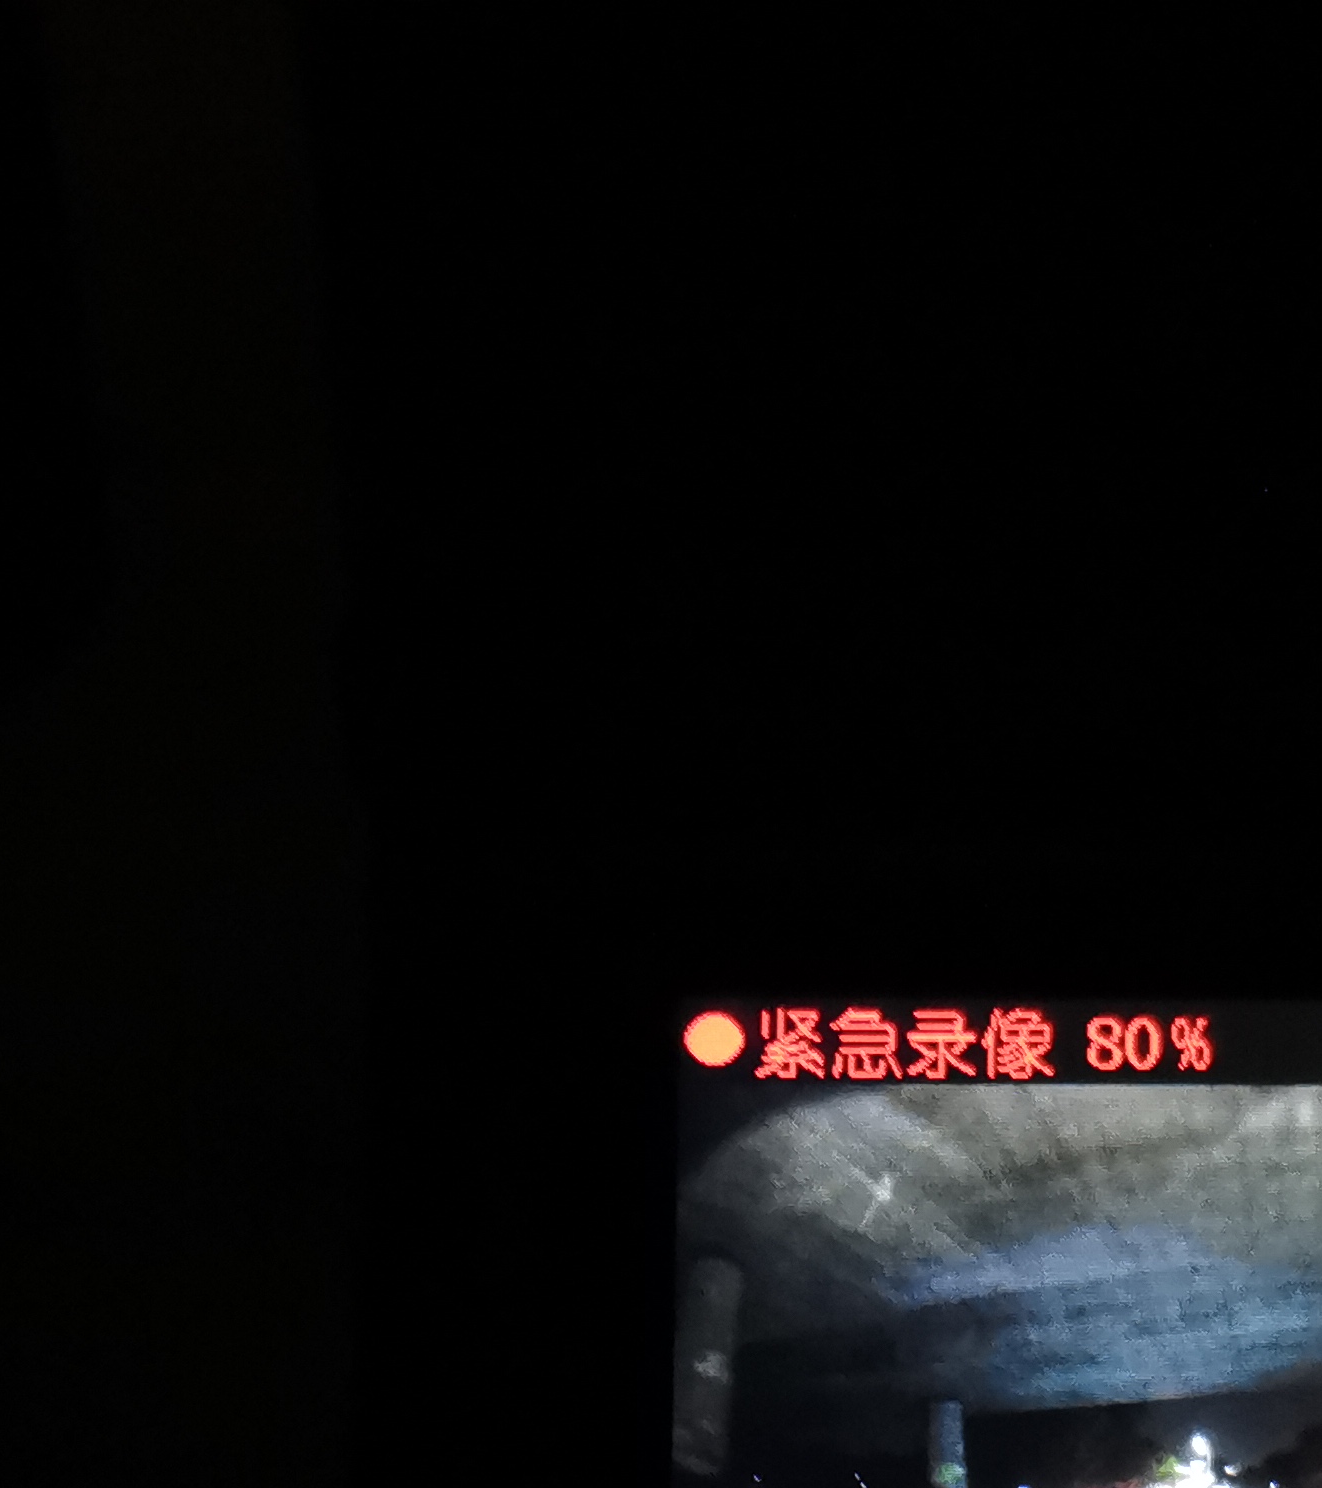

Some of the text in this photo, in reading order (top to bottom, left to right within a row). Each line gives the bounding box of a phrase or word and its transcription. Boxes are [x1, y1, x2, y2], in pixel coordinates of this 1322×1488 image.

[755, 1007, 1214, 1080] 紧急录像 80%
